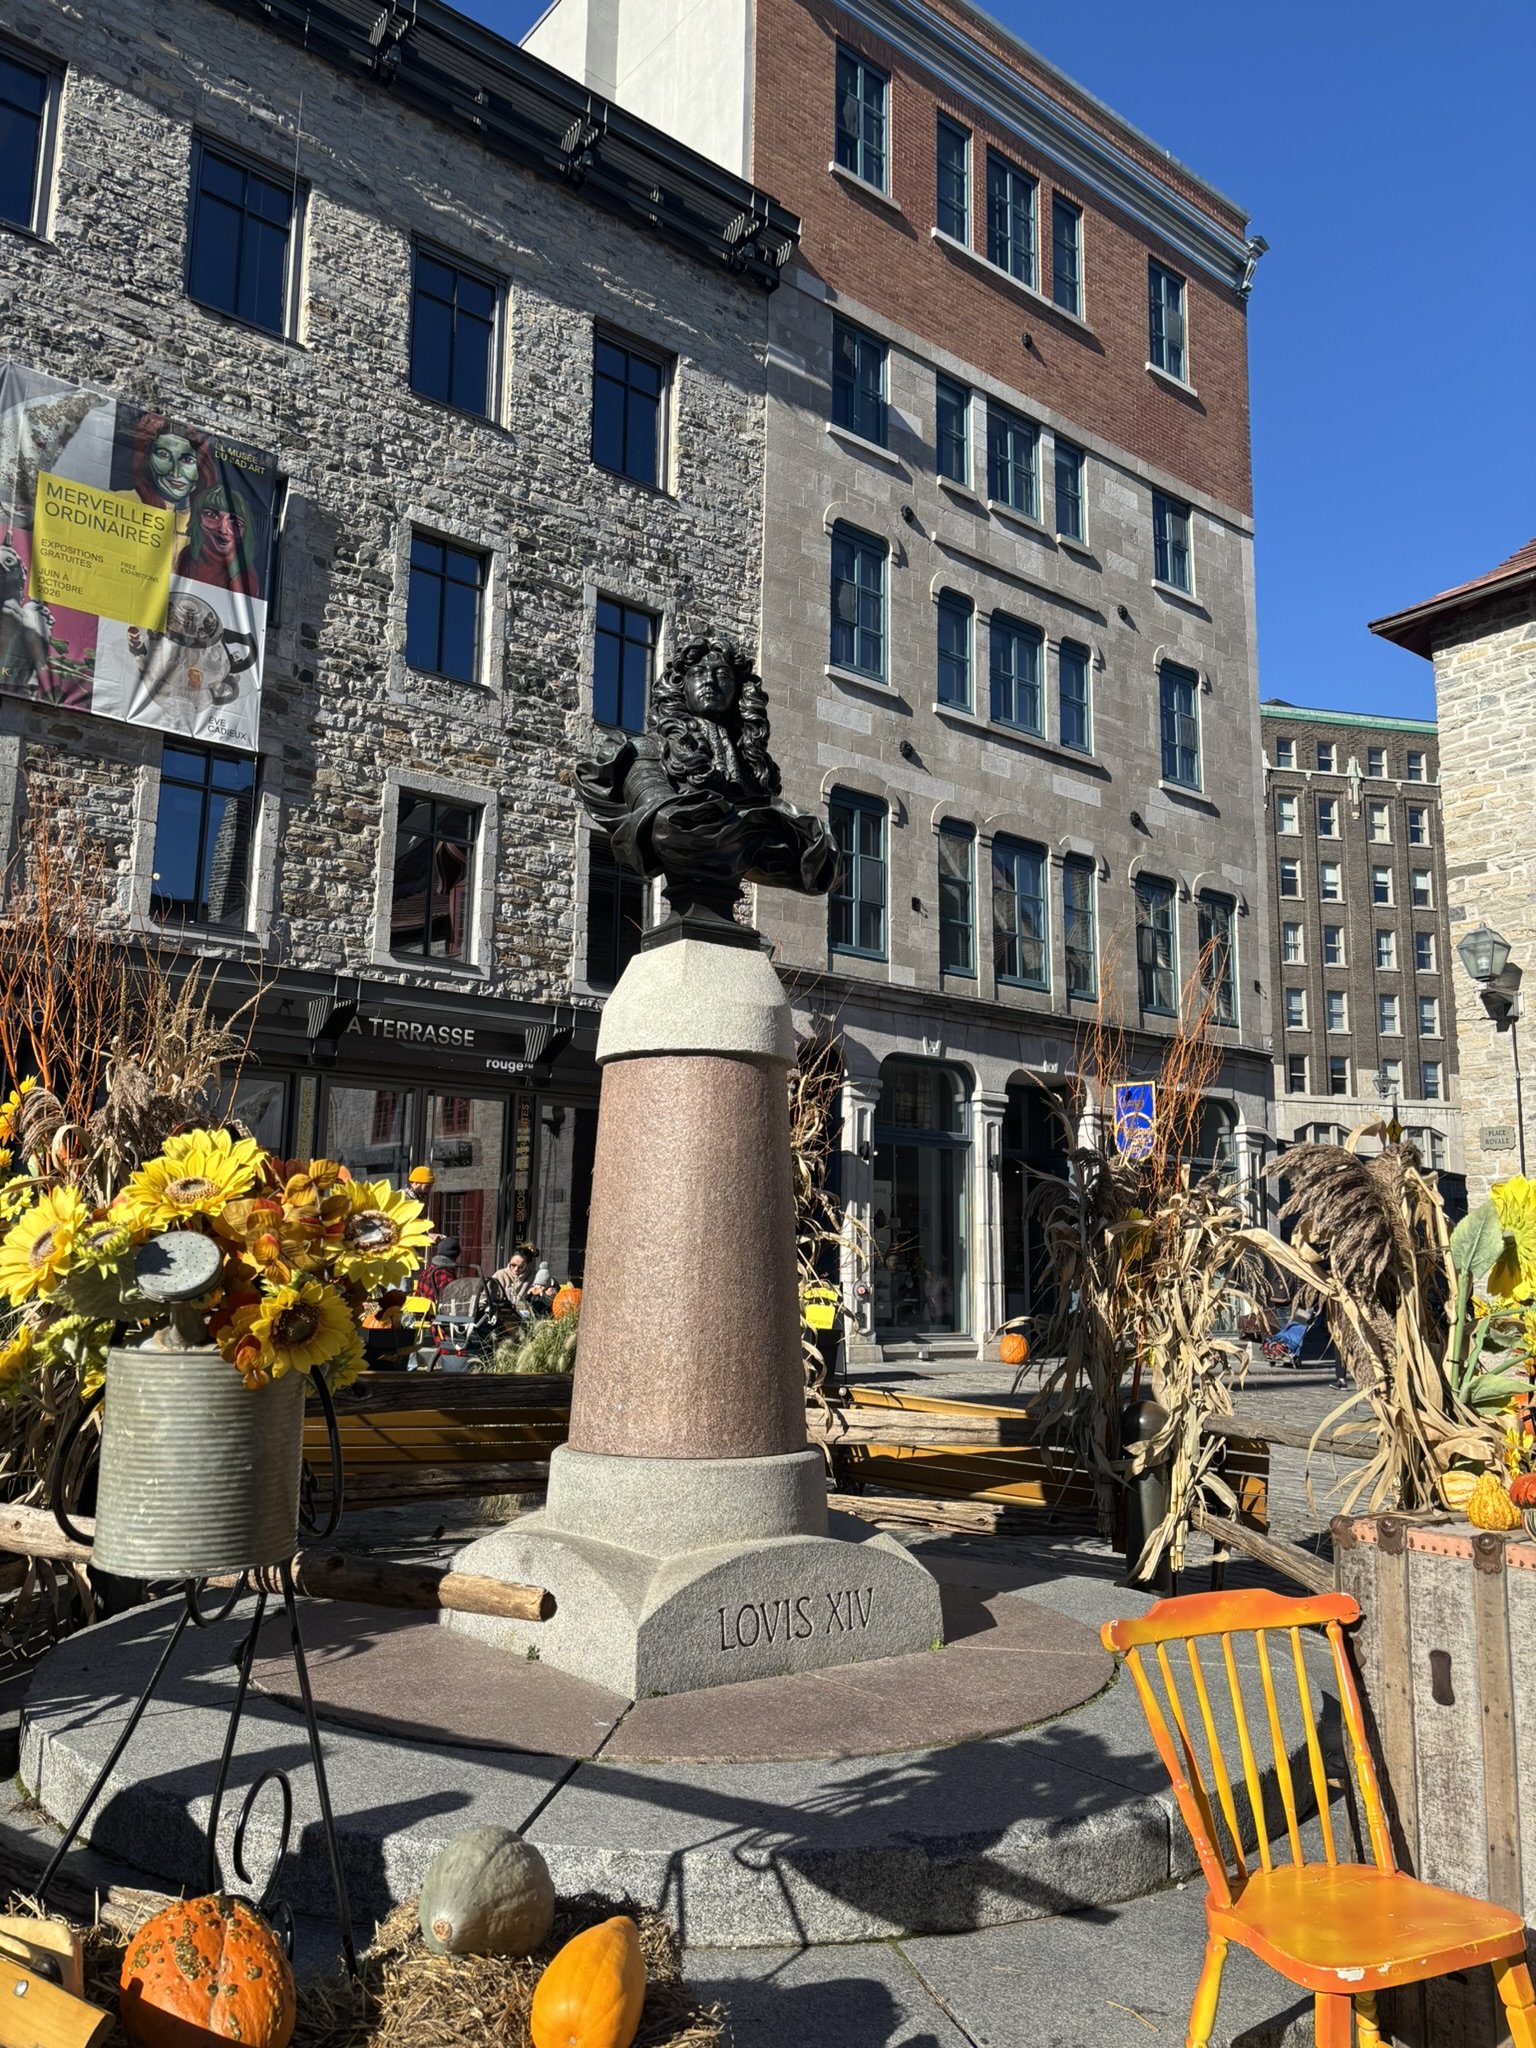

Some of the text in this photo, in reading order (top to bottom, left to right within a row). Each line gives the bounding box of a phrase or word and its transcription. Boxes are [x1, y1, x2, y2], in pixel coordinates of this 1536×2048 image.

[214, 450, 228, 461] DU
[248, 463, 265, 475] ART
[227, 447, 258, 464] MUSÉE
[46, 482, 165, 531] MERVEILLES
[45, 501, 161, 548] ORDINAIRES
[40, 548, 92, 569] GRATUITES
[41, 539, 104, 563] EXPOSITIONS
[39, 568, 60, 579] JUIN
[121, 561, 136, 570] FREE
[38, 576, 84, 595] OCTOBRE
[38, 585, 61, 598] 2026
[208, 725, 246, 740] CADIEUX
[368, 1017, 475, 1047] TERRASSE
[718, 1587, 873, 1650] LOVIS XIV
